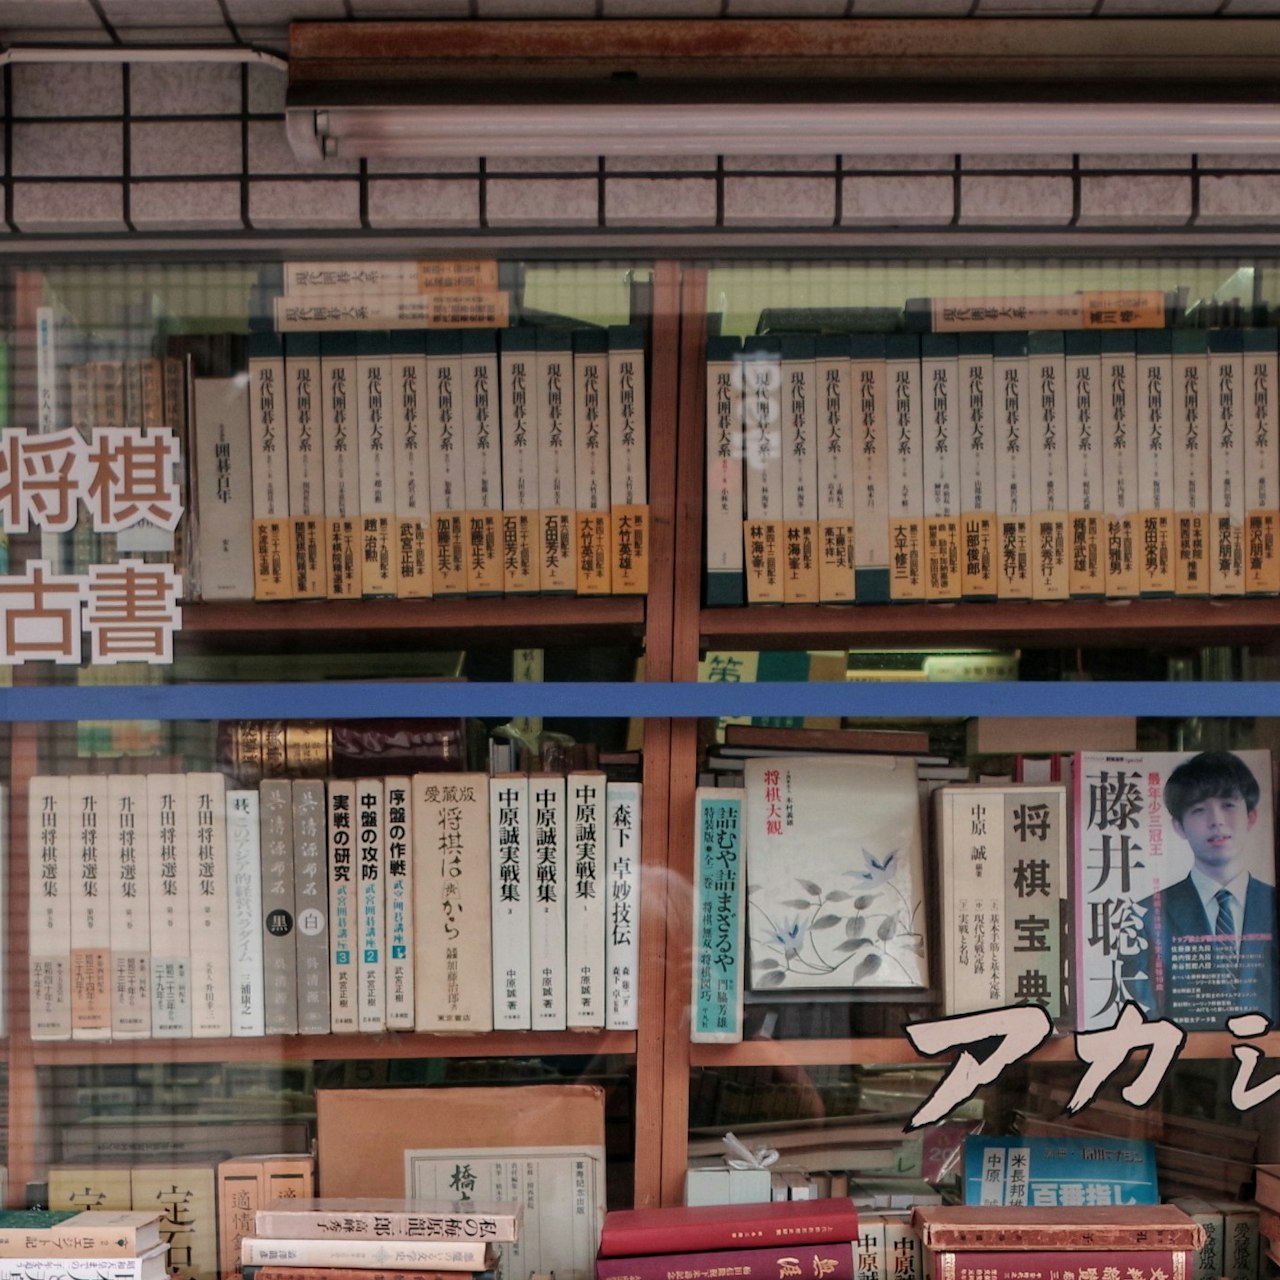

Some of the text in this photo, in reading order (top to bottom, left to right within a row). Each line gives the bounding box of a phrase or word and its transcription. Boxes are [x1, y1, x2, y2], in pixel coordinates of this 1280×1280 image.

[41, 795, 58, 897] 升田将棋選集
[81, 796, 98, 897] 升田将棋選集
[120, 796, 137, 898] 升田将棋選集
[160, 794, 178, 897] 升田将棋選集
[197, 793, 215, 897] 升田将棋選集
[333, 795, 351, 881] 実戦の研究
[361, 793, 378, 881] 中盤の攻防
[389, 789, 406, 877] 序盤の作戦
[499, 788, 520, 902] 中原誠実戦集
[535, 789, 557, 902] 中原誠実戦集
[575, 785, 596, 899] 中原誠実戦集
[764, 770, 783, 836] 将棋大観
